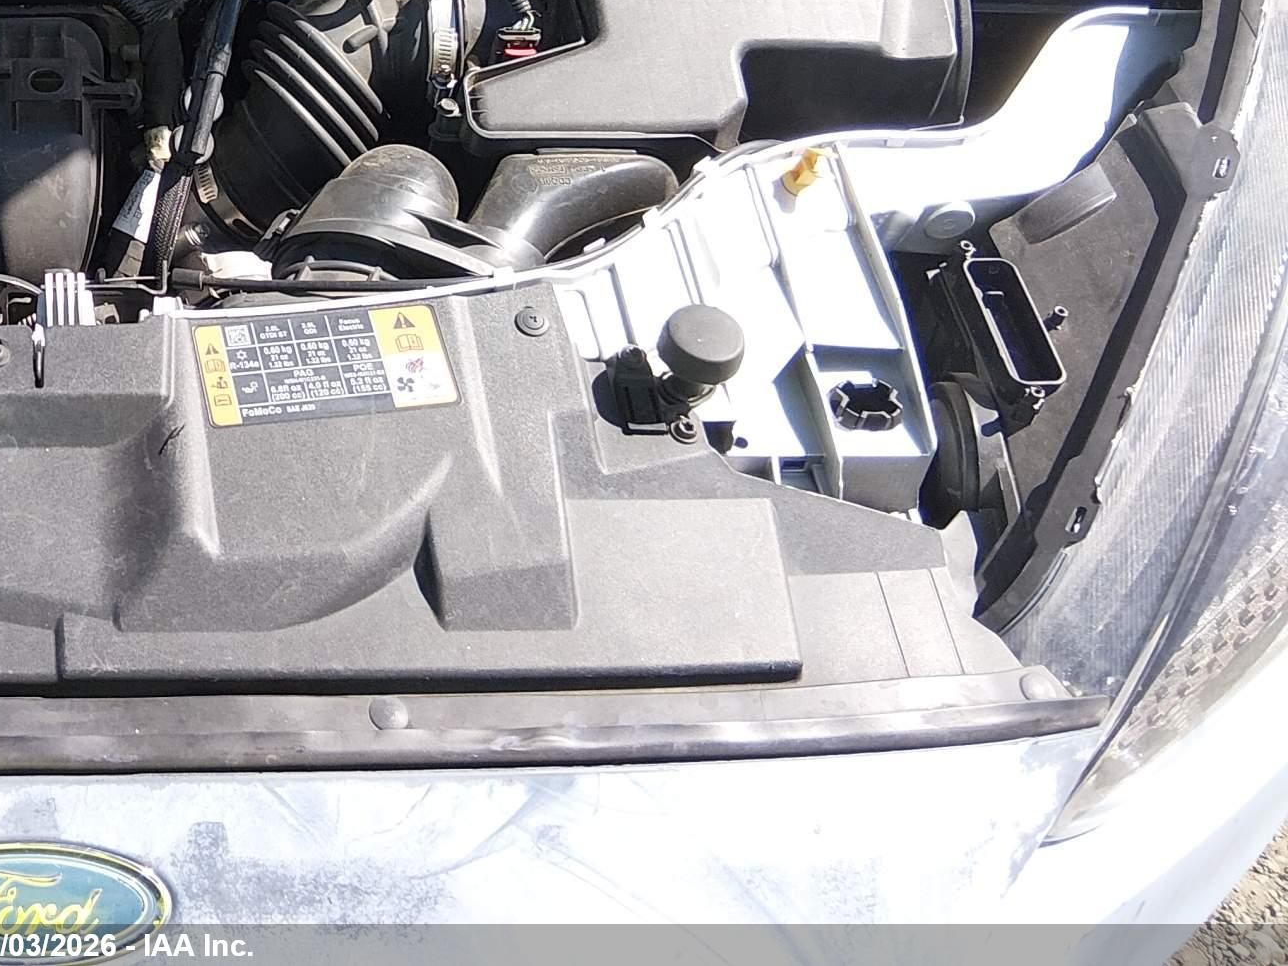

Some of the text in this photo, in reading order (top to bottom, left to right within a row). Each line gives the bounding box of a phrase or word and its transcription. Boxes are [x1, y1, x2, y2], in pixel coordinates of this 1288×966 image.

[300, 341, 330, 351] 0.60 kg
[341, 337, 370, 347] 0.60 kg
[263, 344, 293, 355] 0.60 kg
[230, 361, 259, 370] R-134a
[293, 368, 315, 378] PAG
[322, 381, 330, 389] fl
[330, 380, 341, 388] oz
[364, 376, 371, 384] fl
[372, 375, 384, 383] oz
[290, 384, 302, 392] oz
[330, 387, 345, 397] cc)
[373, 382, 387, 392] cc)
[292, 391, 305, 401] cc)
[241, 406, 282, 418] FoMoCo
